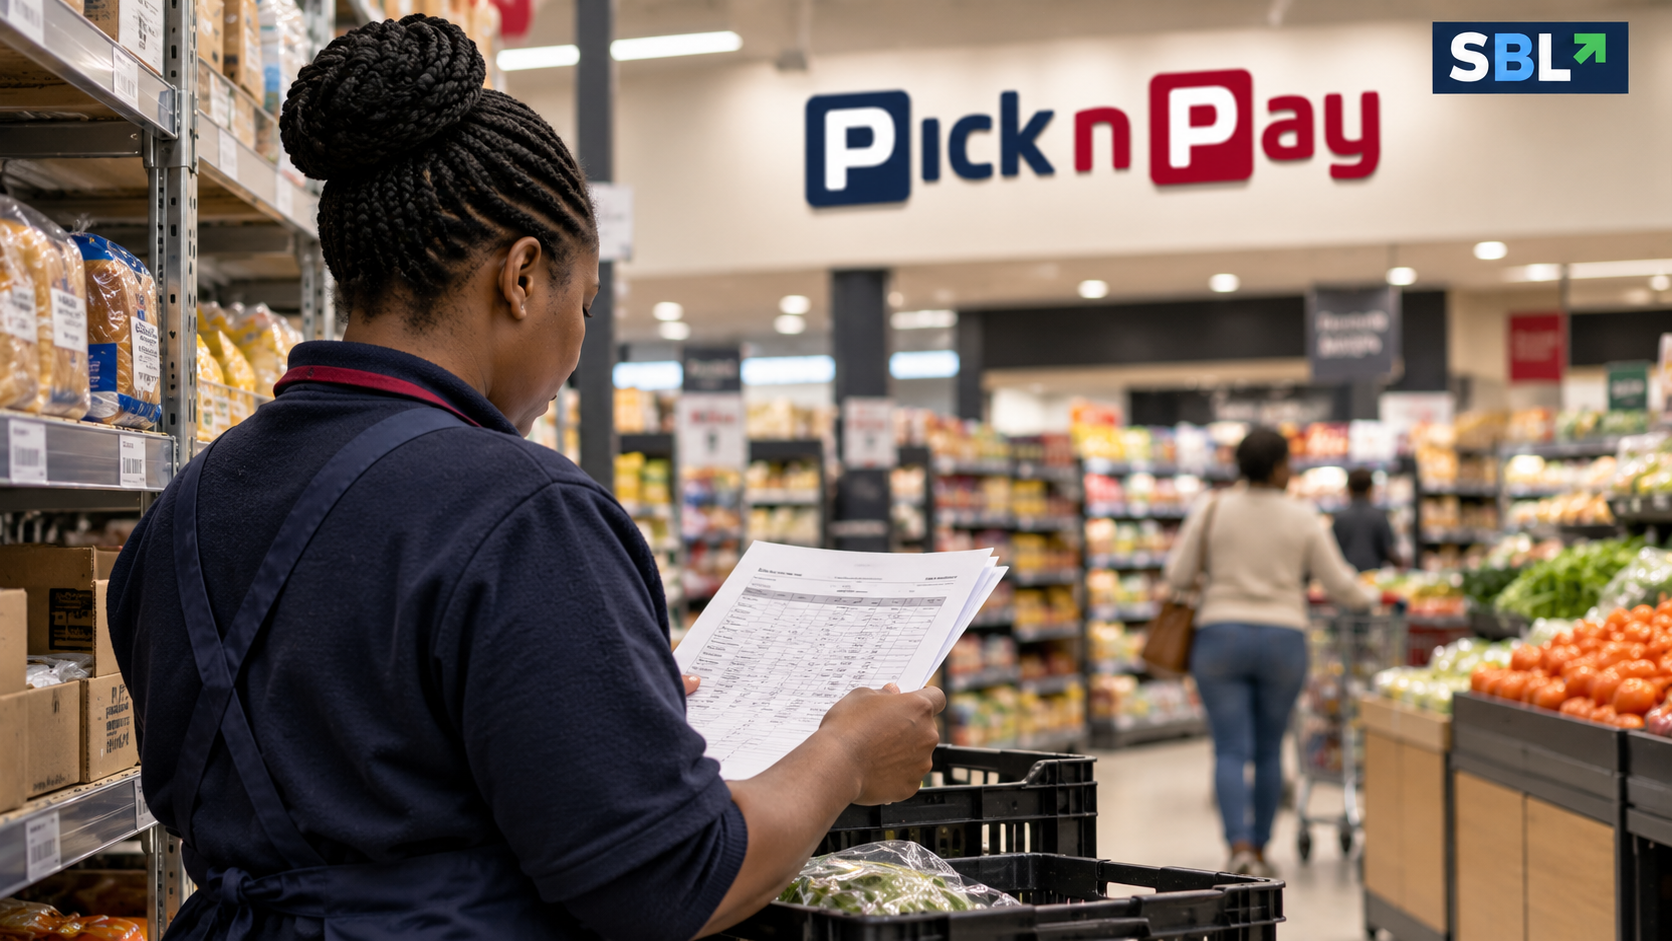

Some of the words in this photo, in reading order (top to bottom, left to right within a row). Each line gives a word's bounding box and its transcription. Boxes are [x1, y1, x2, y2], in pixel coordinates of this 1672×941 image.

[823, 90, 1056, 191] Pick
[1074, 106, 1131, 172] n
[1167, 85, 1381, 180] Pay
